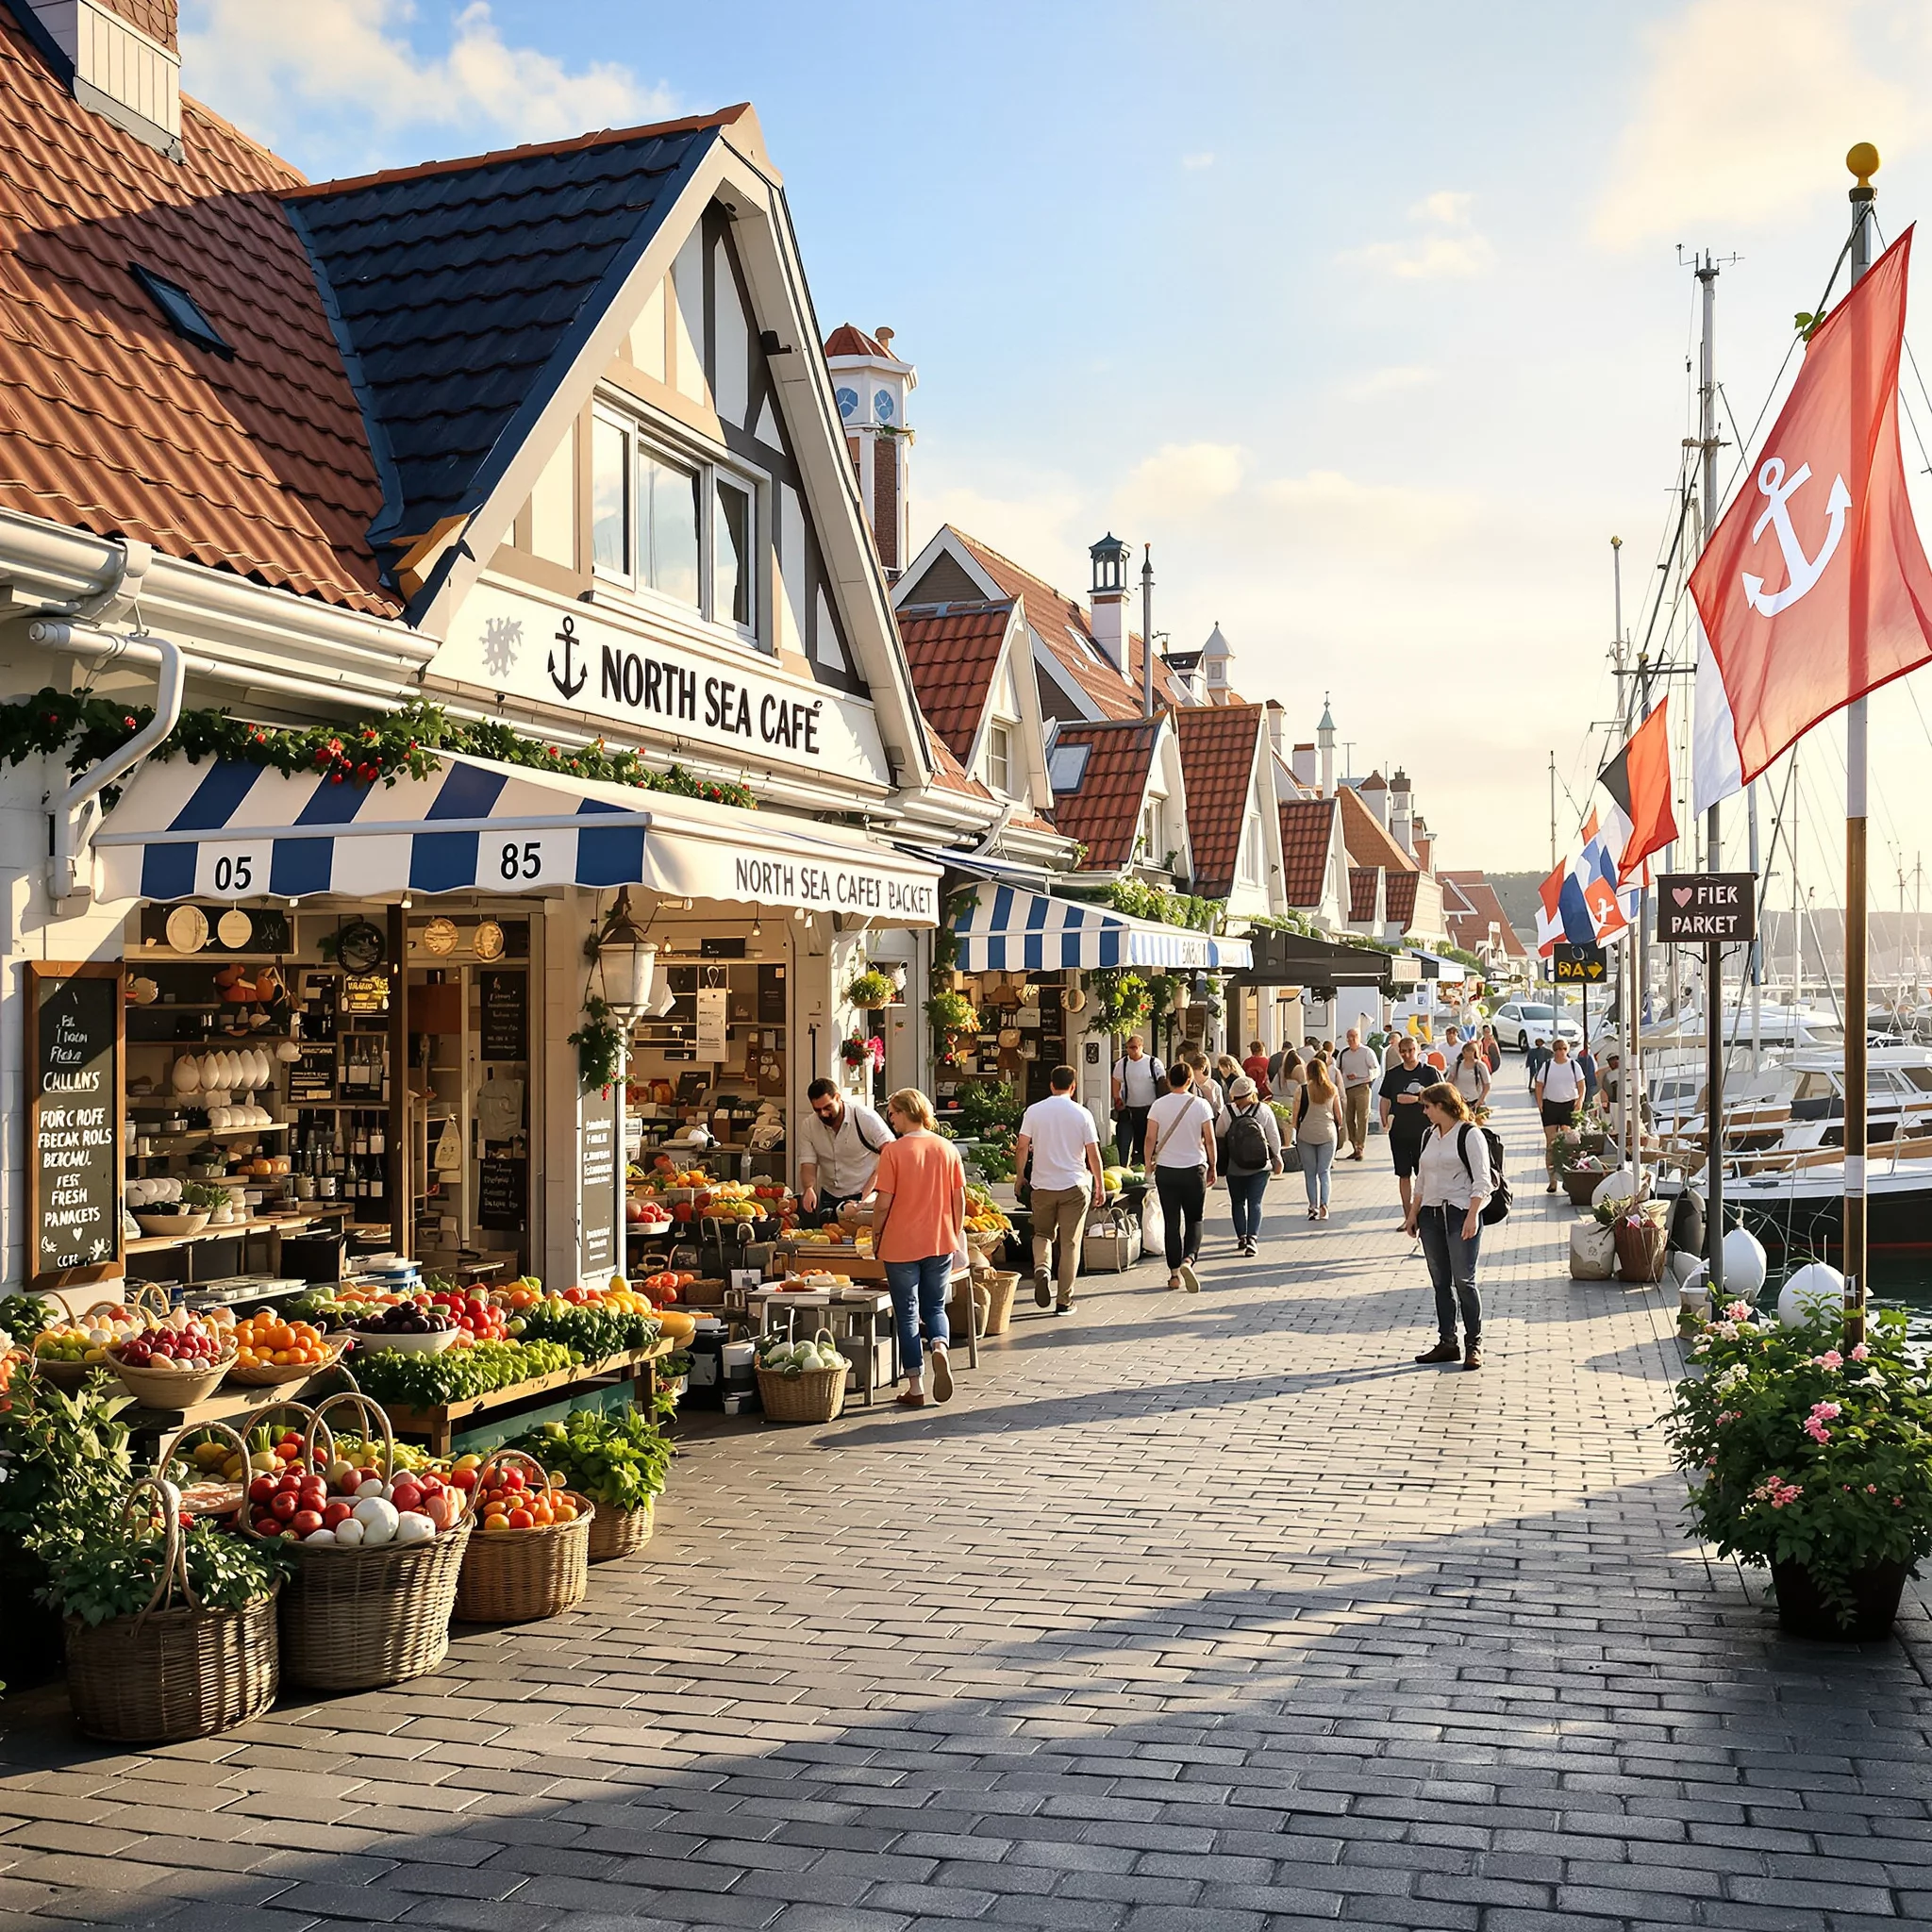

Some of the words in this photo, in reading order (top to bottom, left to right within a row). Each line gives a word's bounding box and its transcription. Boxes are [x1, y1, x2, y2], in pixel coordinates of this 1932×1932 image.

[602, 644, 696, 722] NORTH
[705, 676, 753, 739] SEA
[760, 692, 824, 755] CAFÉ
[214, 856, 252, 891] 05
[500, 841, 541, 880] 85
[736, 858, 793, 896] NORTH
[801, 867, 830, 901] SEA
[1697, 886, 1739, 905] FIEK
[1671, 915, 1738, 934] PARKET
[51, 1189, 88, 1206] FRESH
